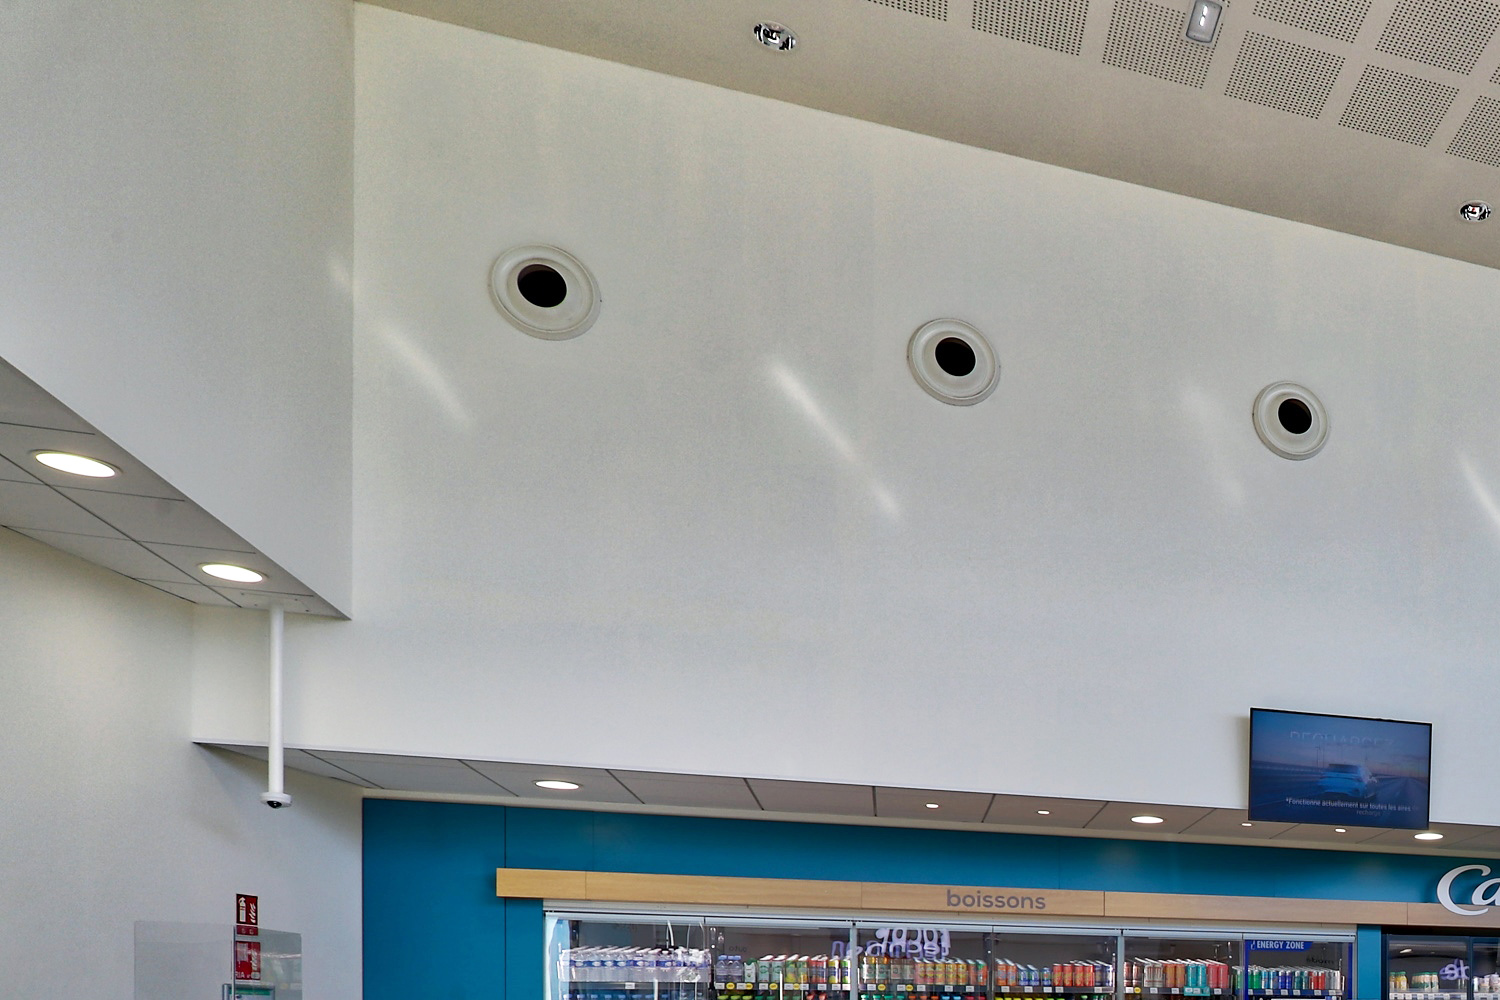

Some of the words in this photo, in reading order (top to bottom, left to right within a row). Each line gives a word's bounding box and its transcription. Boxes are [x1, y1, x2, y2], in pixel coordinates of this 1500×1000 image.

[946, 889, 1046, 910] boissons
[1257, 941, 1284, 950] ENERGY
[1286, 941, 1305, 950] ZONE
